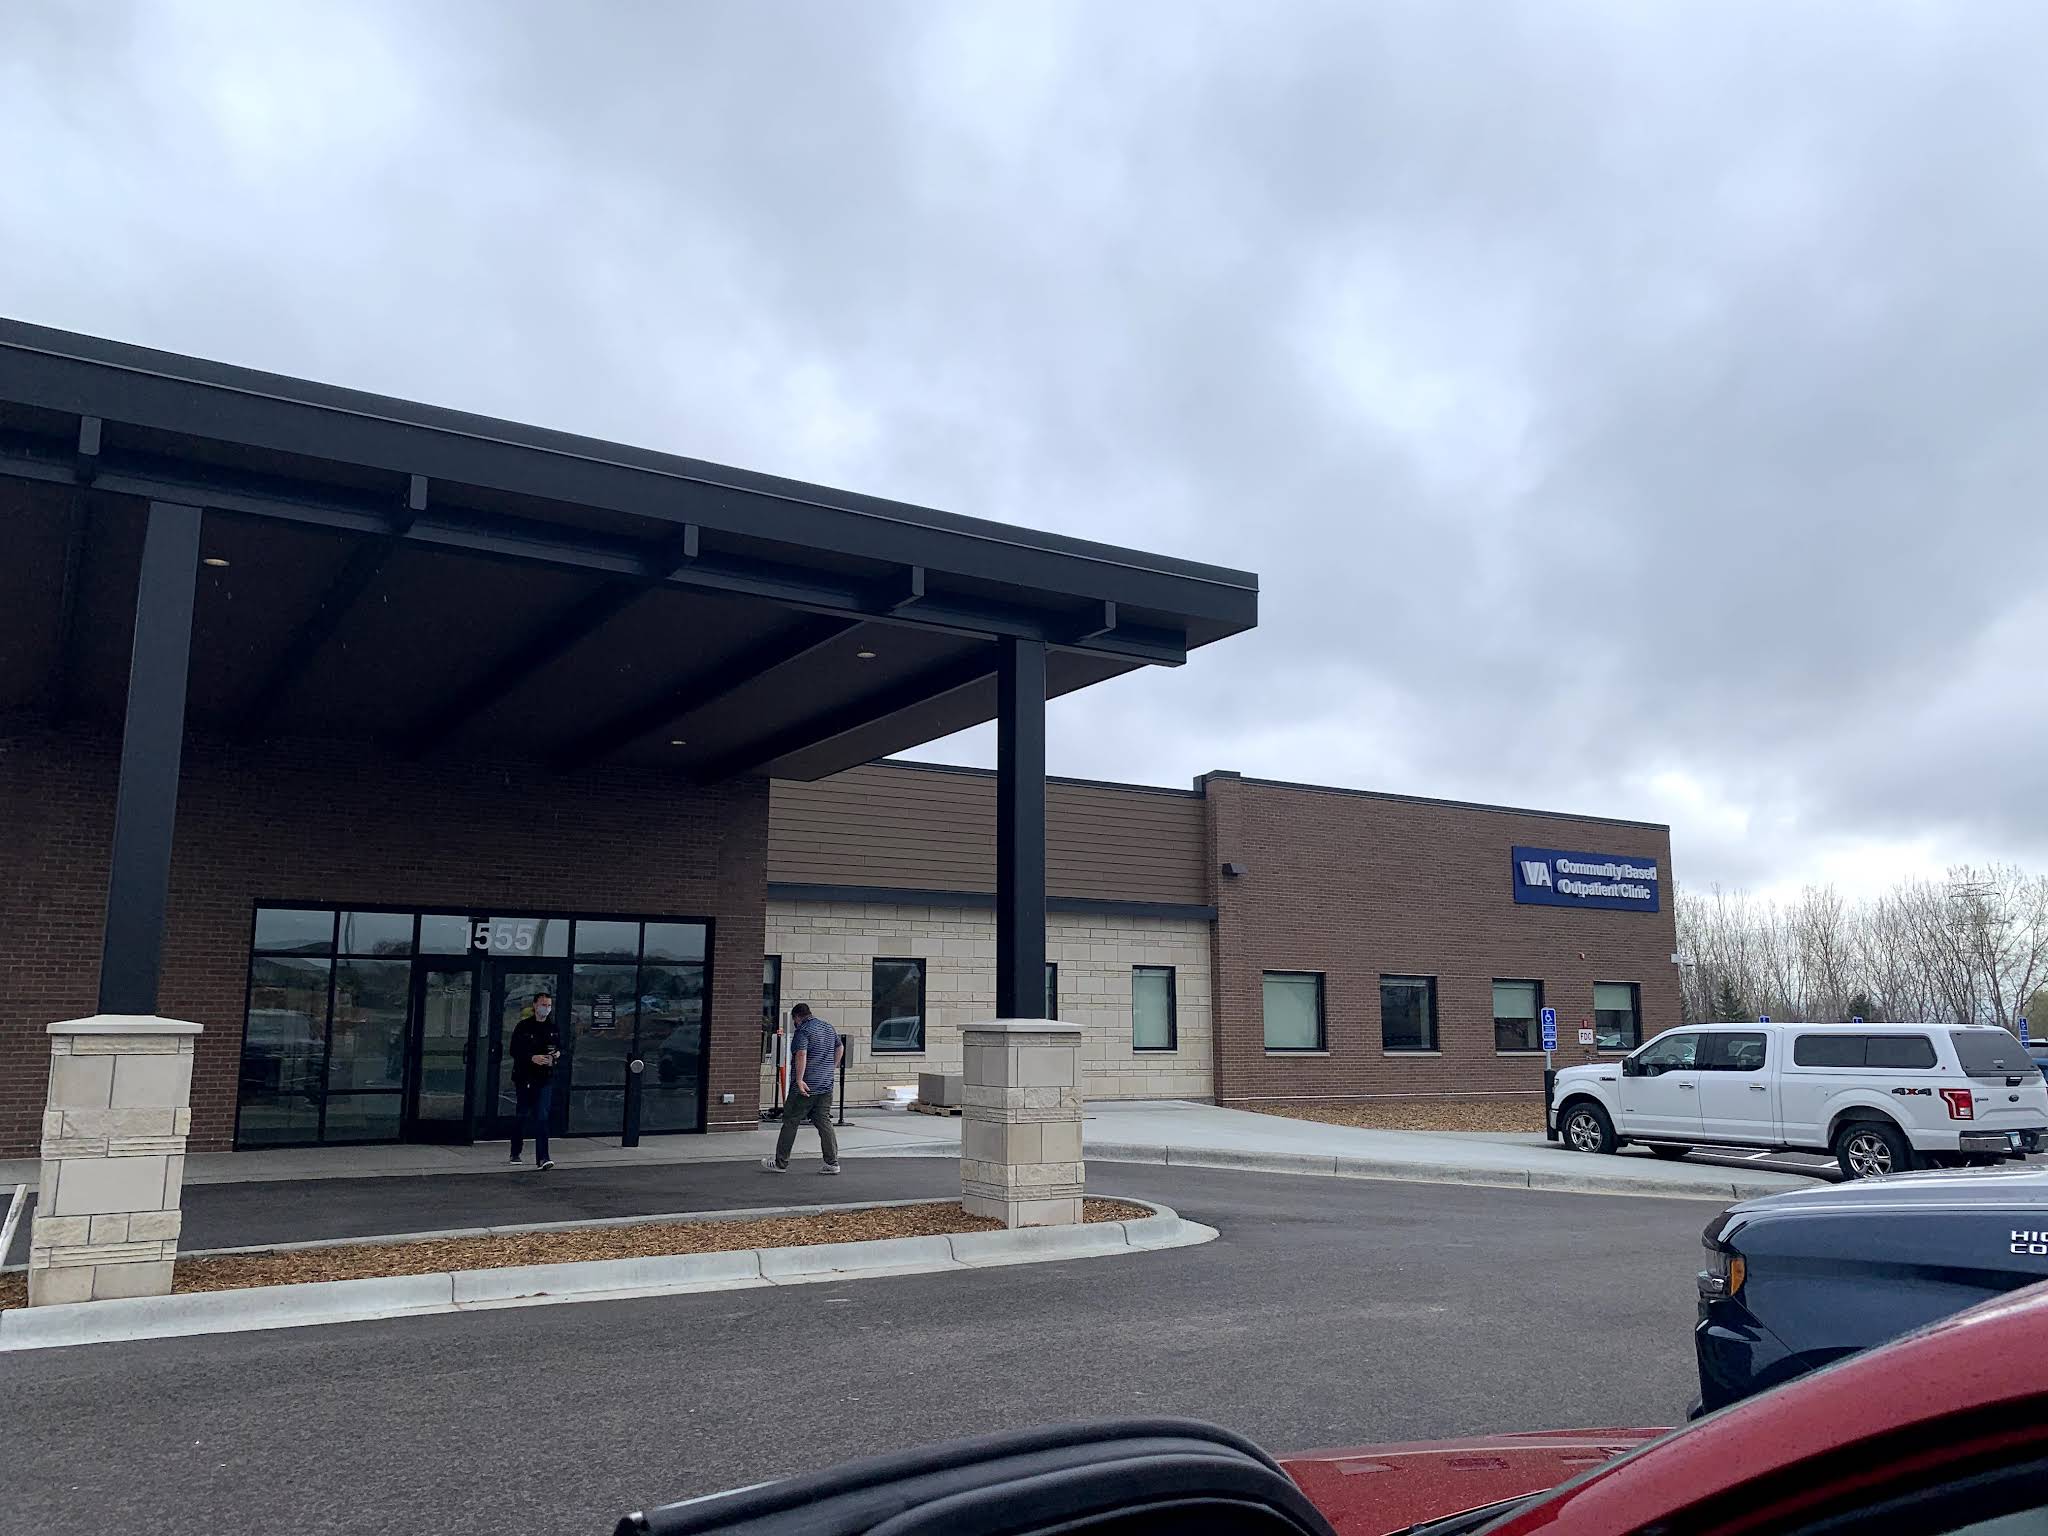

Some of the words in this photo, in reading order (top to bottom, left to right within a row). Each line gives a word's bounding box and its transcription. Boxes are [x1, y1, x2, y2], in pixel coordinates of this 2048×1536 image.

[1520, 860, 1551, 887] VA
[1556, 858, 1622, 880] Community
[1623, 864, 1657, 881] Based
[1558, 879, 1619, 898] Outpatient
[1620, 884, 1651, 899] Clinic
[464, 922, 532, 950] 1555
[1580, 1032, 1592, 1041] FDC
